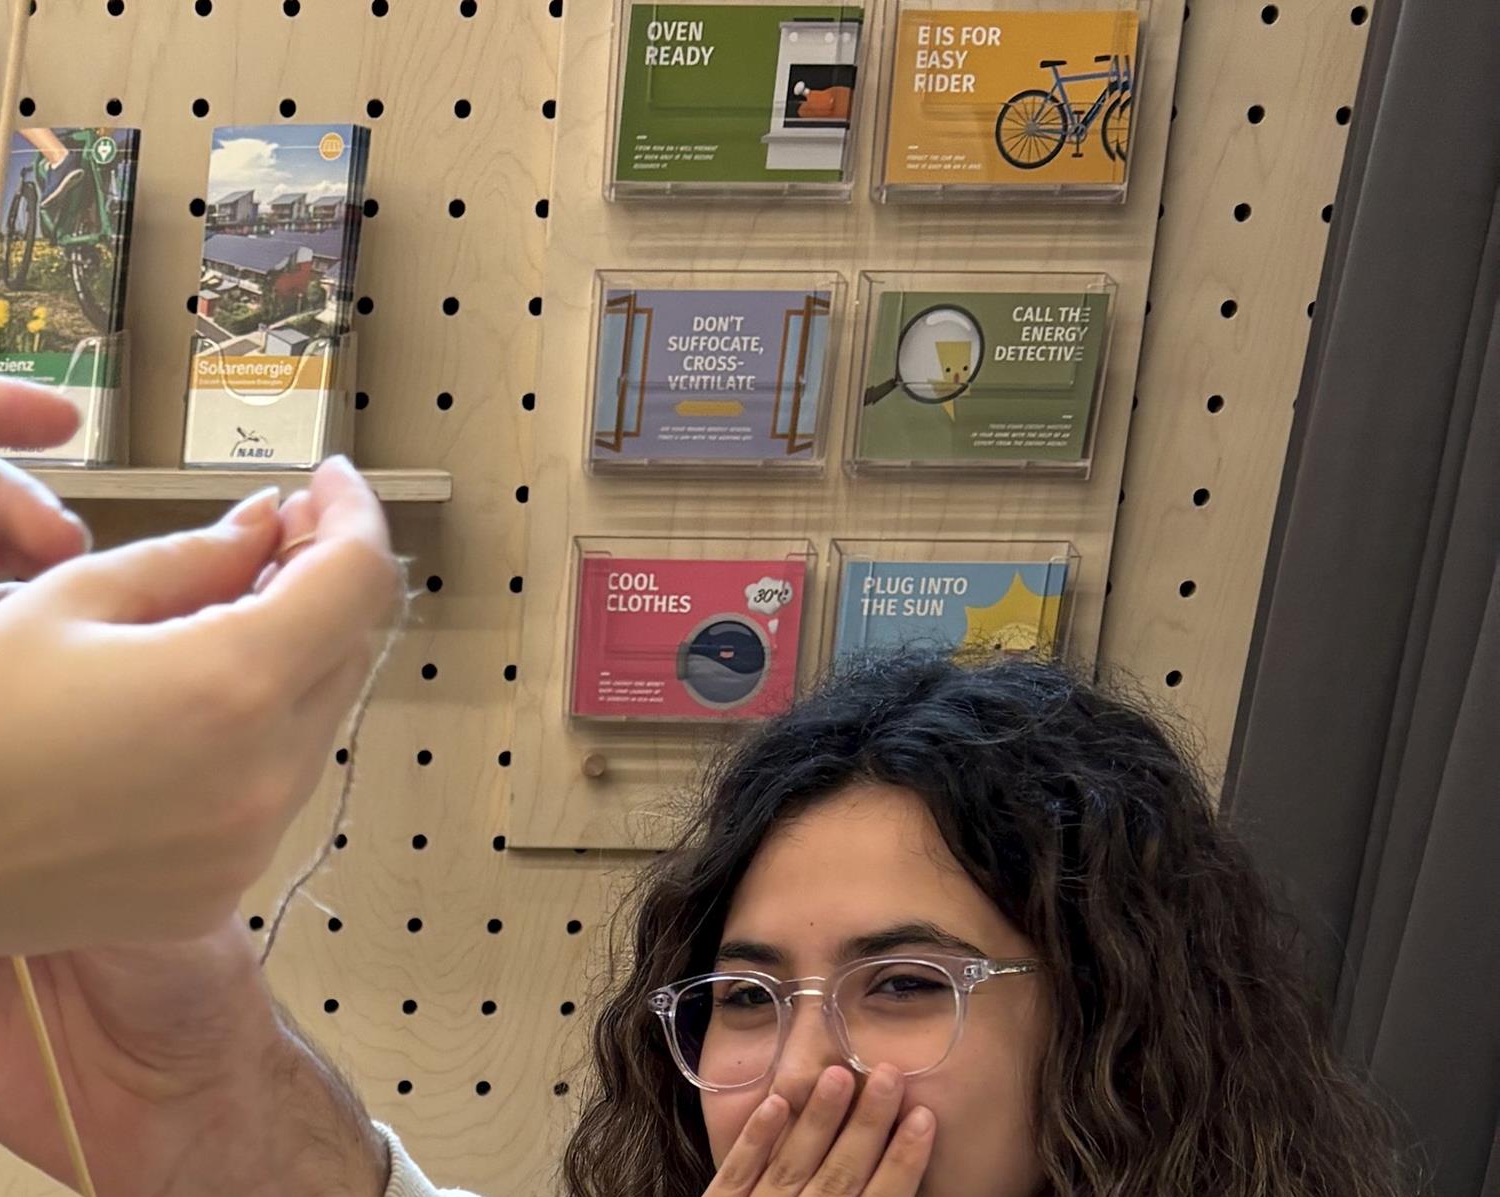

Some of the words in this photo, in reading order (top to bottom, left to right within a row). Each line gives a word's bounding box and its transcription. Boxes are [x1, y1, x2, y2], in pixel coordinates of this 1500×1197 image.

[648, 22, 703, 41] OVEN
[918, 26, 930, 44] E
[936, 27, 956, 45] IS
[961, 27, 1001, 46] FOR
[645, 46, 714, 66] READY
[916, 50, 968, 68] EASY
[914, 74, 977, 93] RIDER
[1012, 306, 1053, 322] CALL
[1058, 307, 1091, 322] THE
[1021, 326, 1088, 341] ENERGY
[667, 336, 764, 355] SUFFOCATE,
[994, 346, 1084, 361] DETECTIVE
[199, 360, 292, 378] Solarenergie
[683, 356, 744, 371] CROSS-
[668, 375, 756, 390] VENTILATE
[237, 448, 274, 458] NABU
[608, 573, 659, 591] COOL
[864, 578, 914, 595] PLUG
[919, 578, 968, 595] INTO
[606, 595, 692, 613] CLOTHES
[862, 598, 897, 616] THE
[902, 599, 944, 616] SUN
